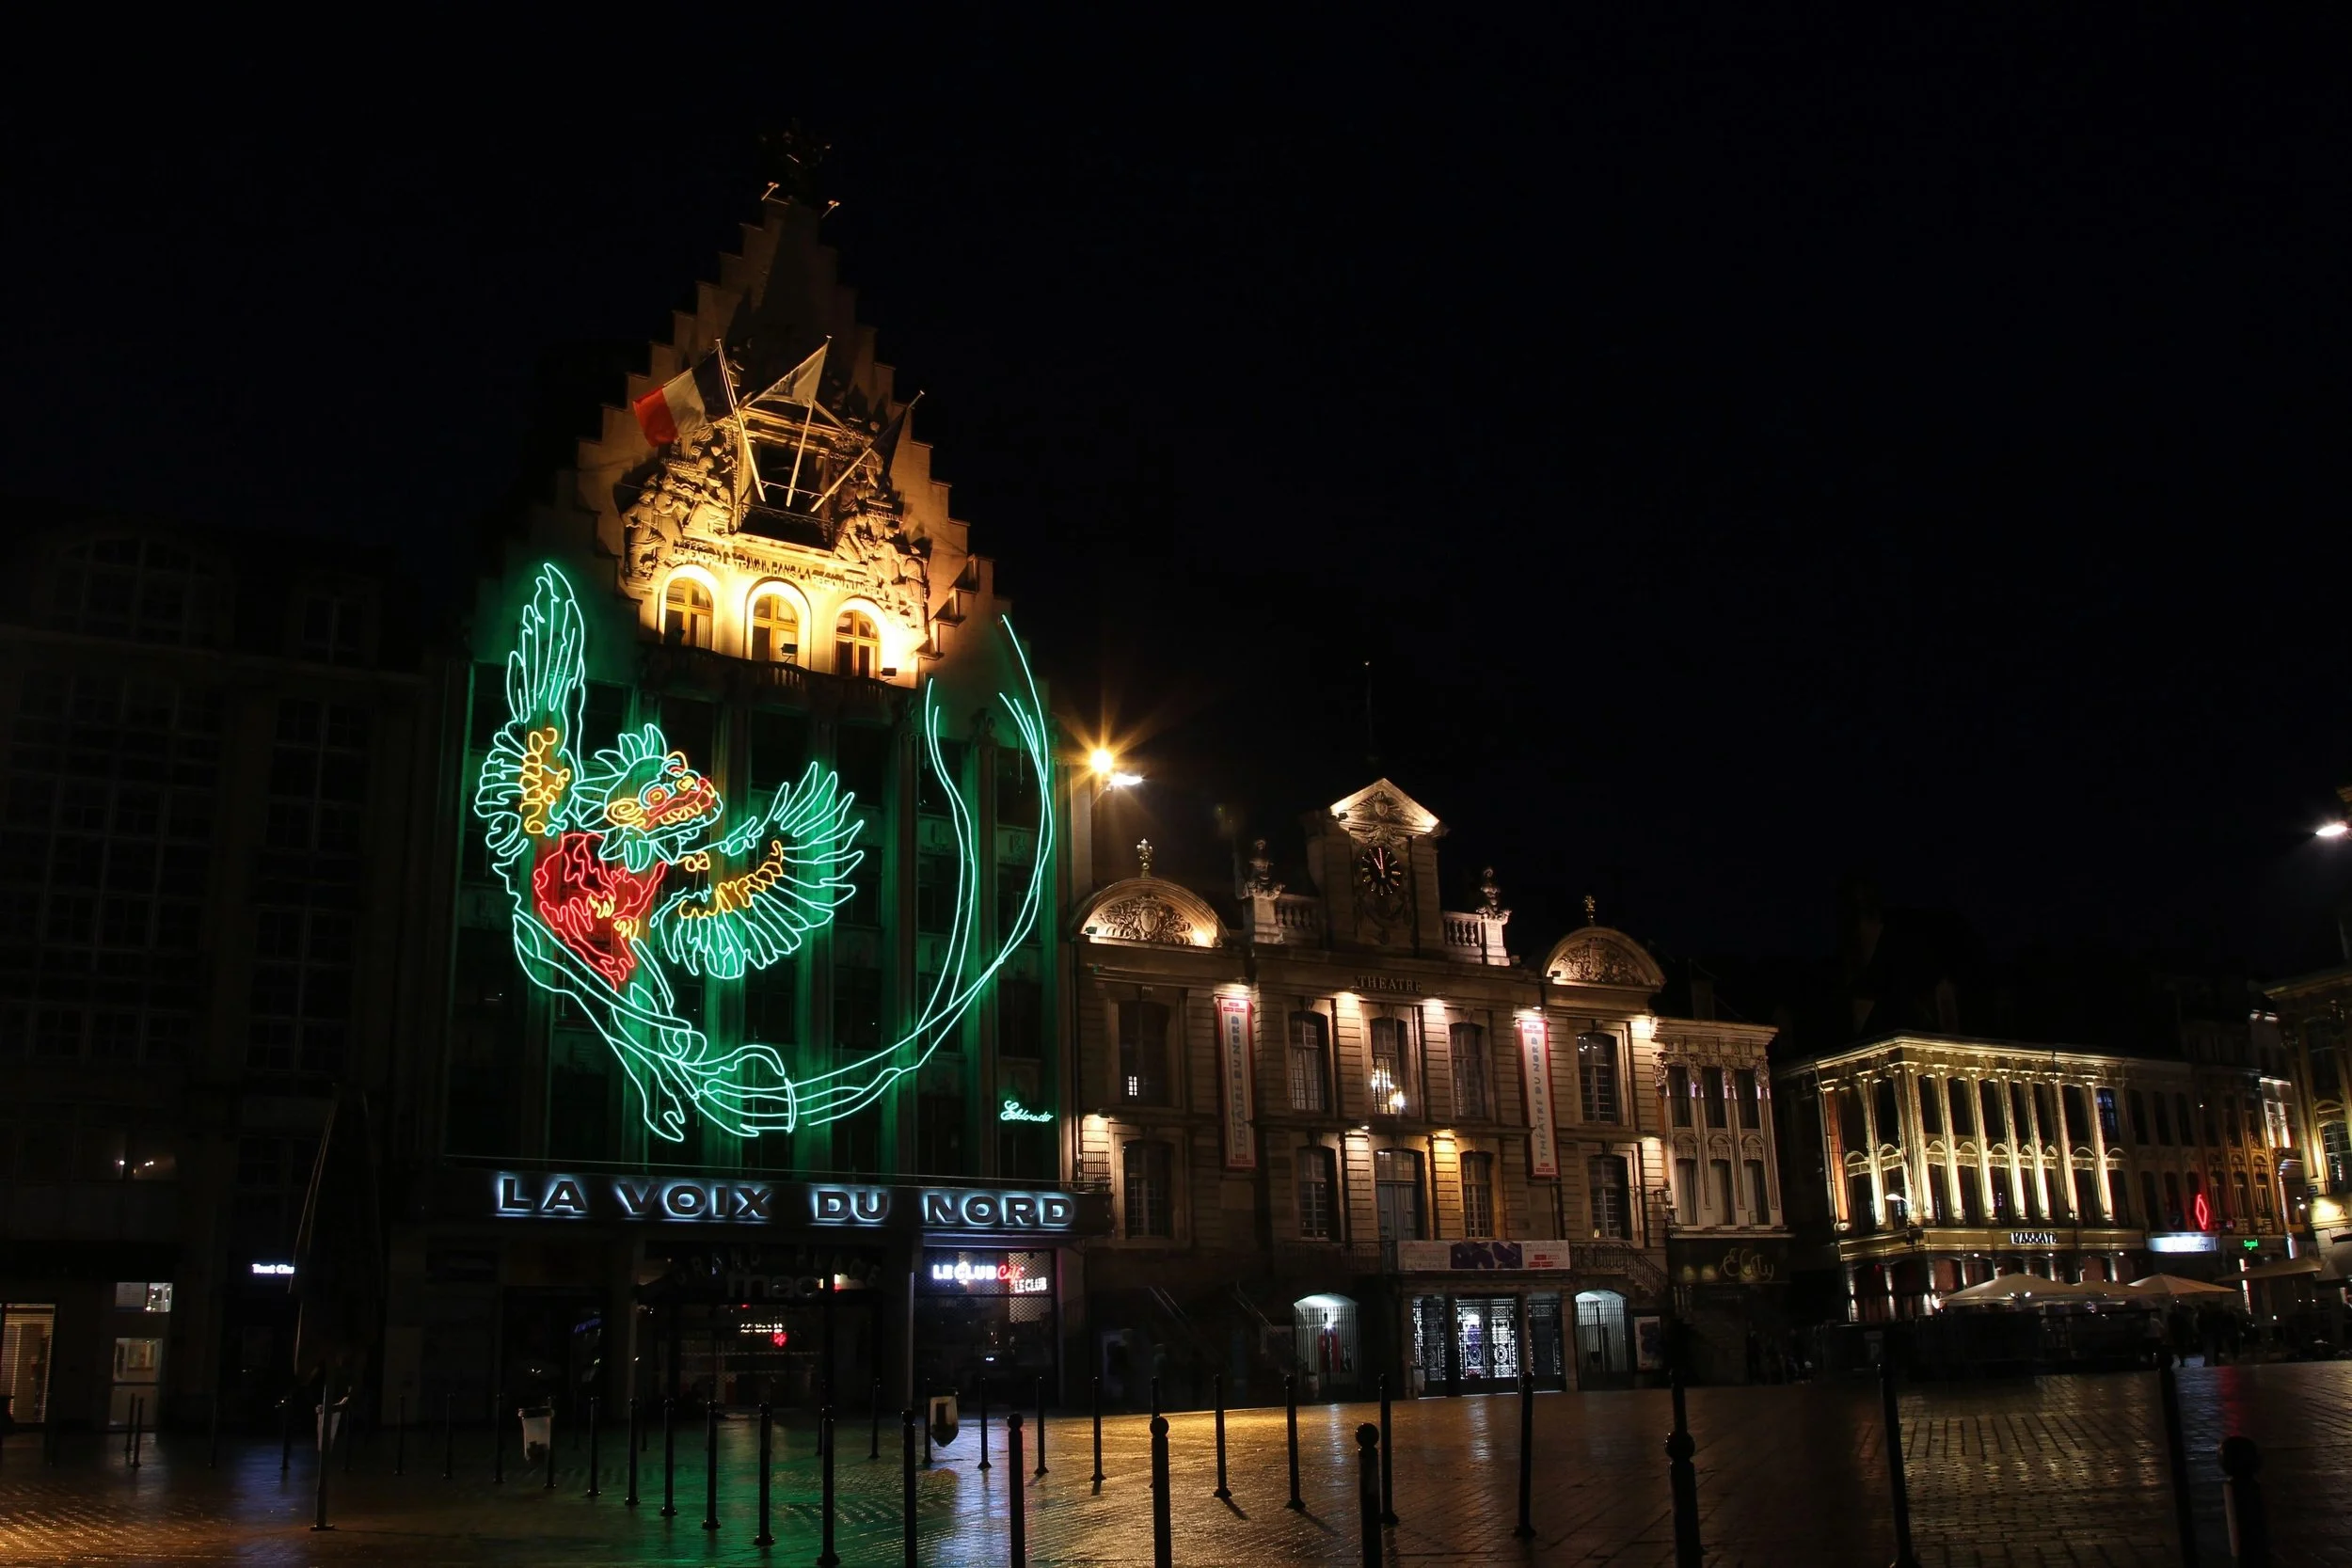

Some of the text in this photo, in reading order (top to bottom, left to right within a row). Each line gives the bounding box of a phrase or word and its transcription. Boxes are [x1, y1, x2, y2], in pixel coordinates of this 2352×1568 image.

[1356, 975, 1422, 992] THEATRE
[1231, 1015, 1241, 1054] NORD
[1531, 1037, 1540, 1072] NORD
[499, 1176, 1076, 1227] LA VOIX DU NORD
[932, 1264, 953, 1280] LE
[954, 1264, 997, 1281] CLUB
